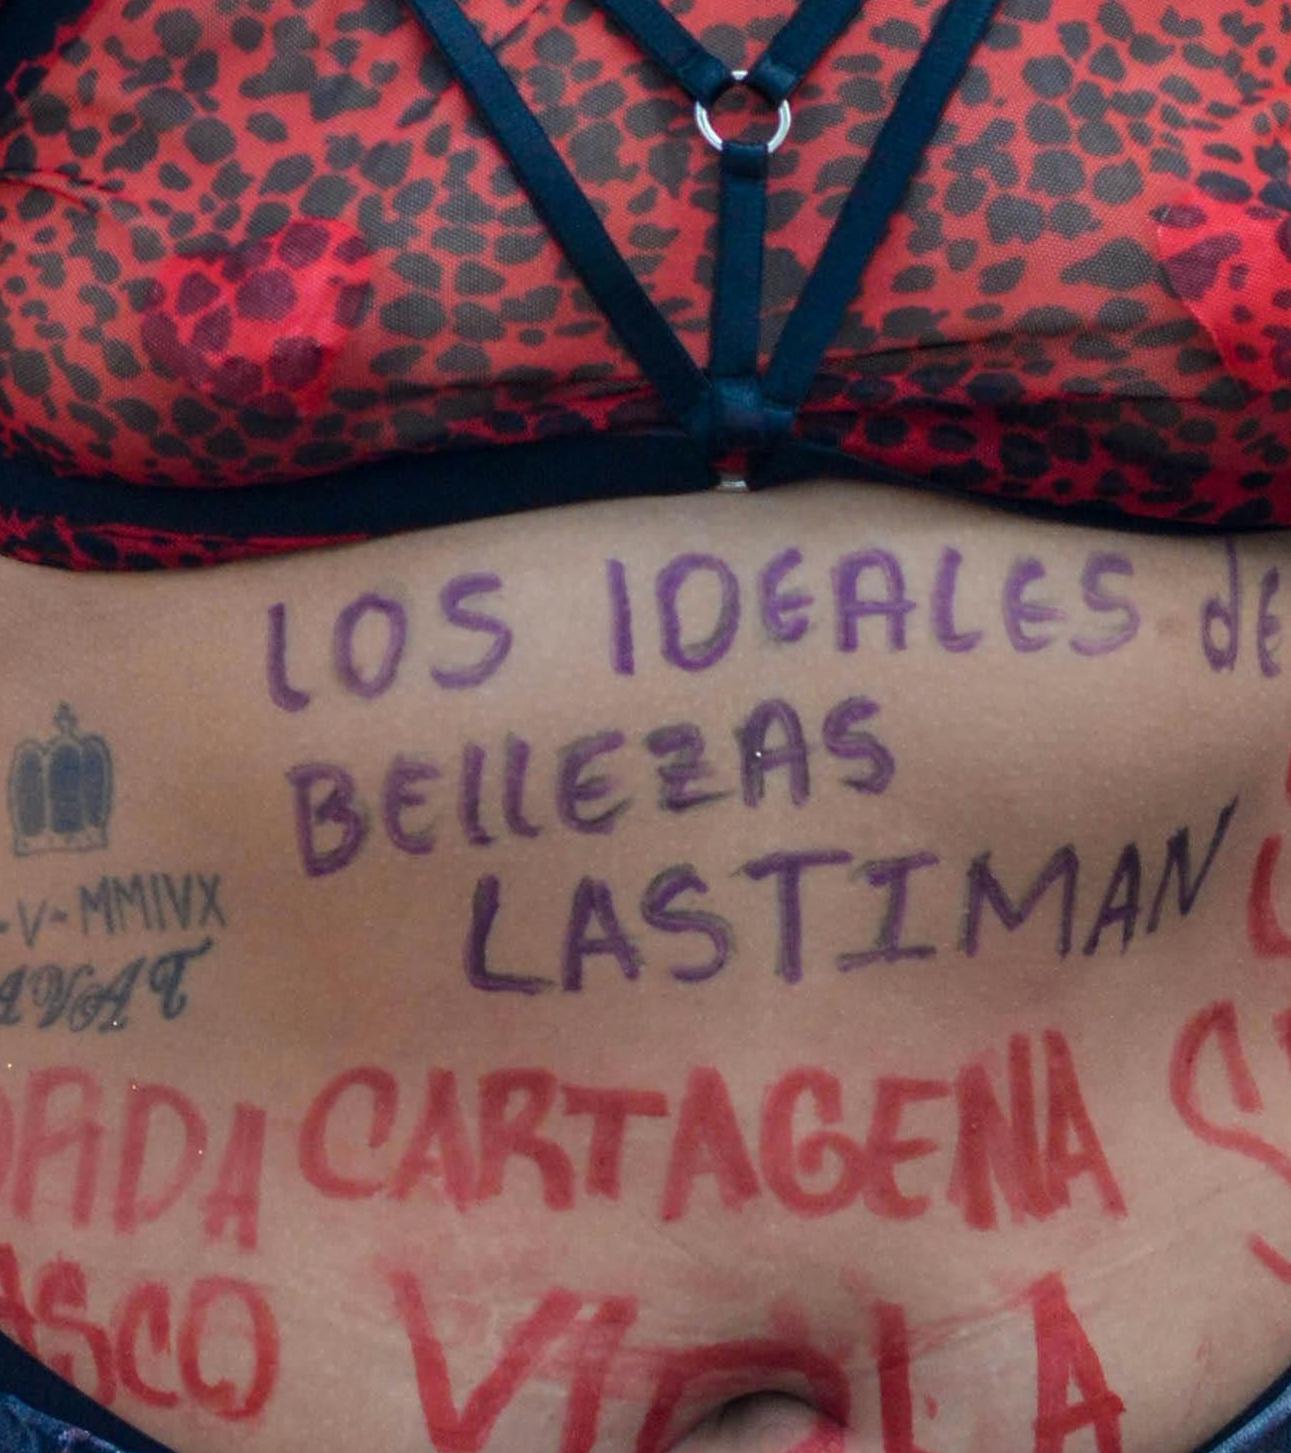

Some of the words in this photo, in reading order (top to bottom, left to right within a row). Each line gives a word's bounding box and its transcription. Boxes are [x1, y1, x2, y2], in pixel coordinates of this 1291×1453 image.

[265, 574, 514, 712] LOS
[606, 545, 1142, 677] IDEALES
[463, 796, 1240, 994] LASTIMAN
[298, 1027, 1129, 1222] CARTAGENA
